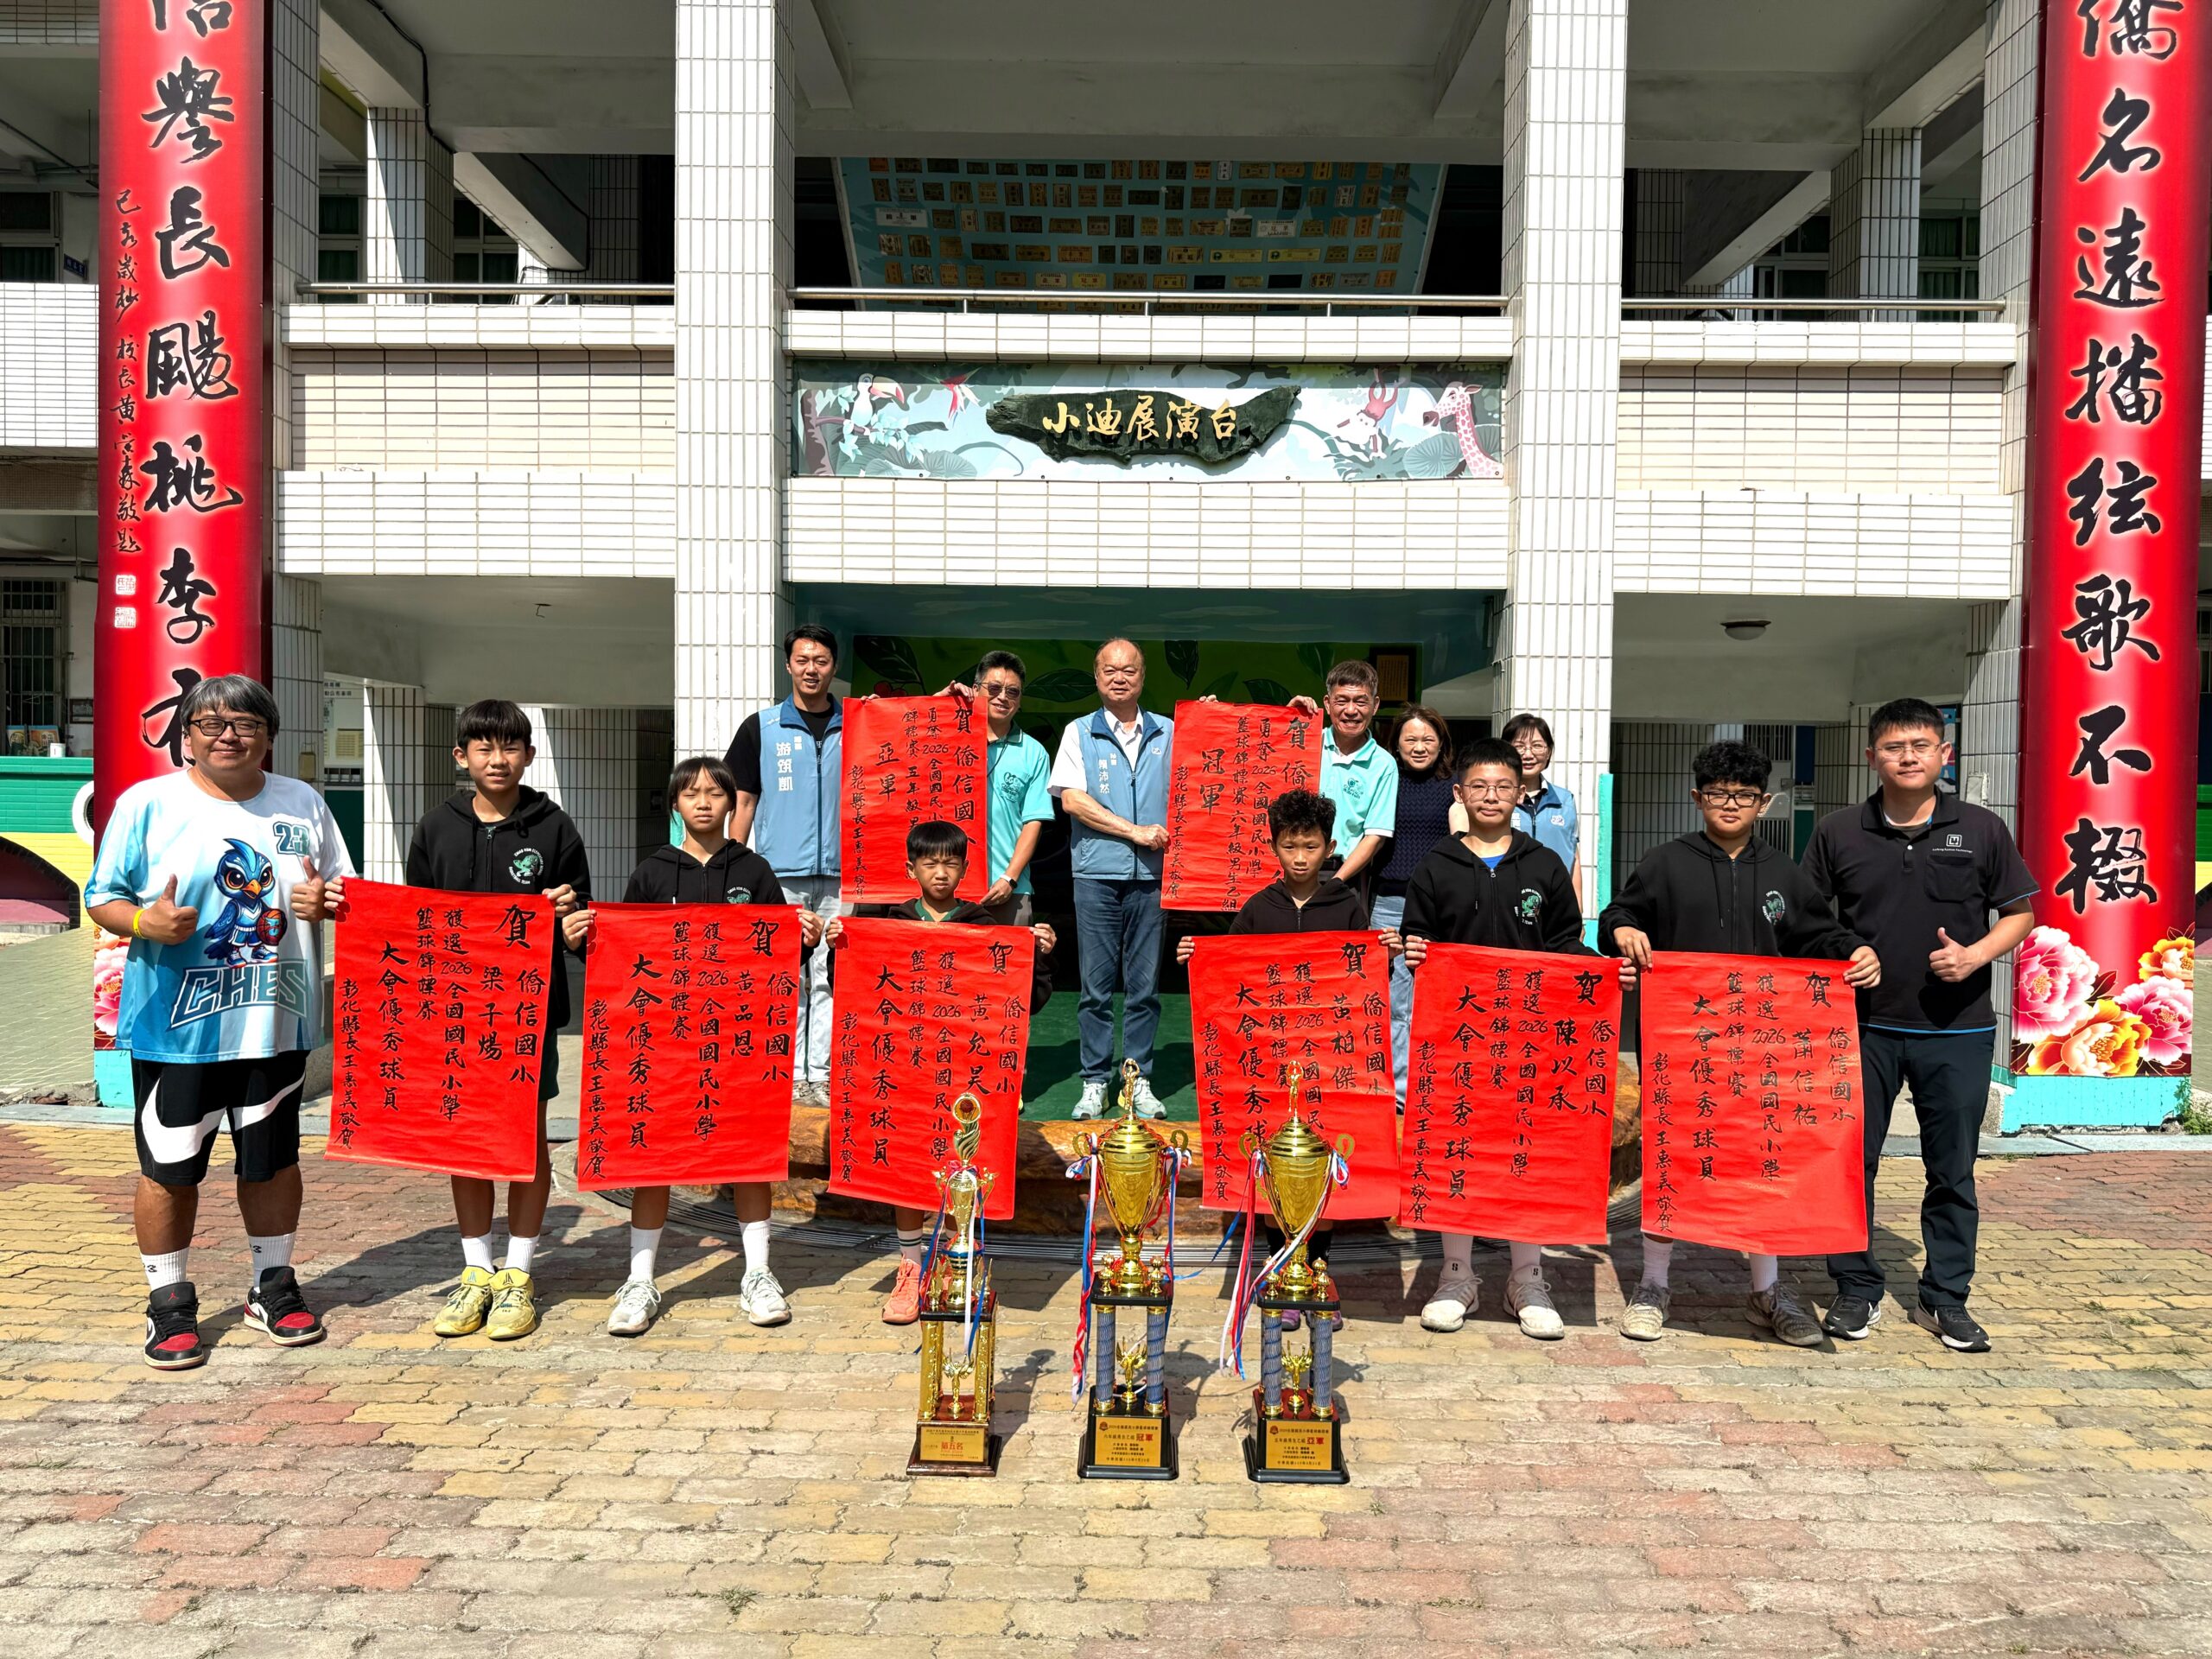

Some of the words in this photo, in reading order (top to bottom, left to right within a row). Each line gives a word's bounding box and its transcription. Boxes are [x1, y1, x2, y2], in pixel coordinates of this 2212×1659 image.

[1042, 395, 1236, 441] 小迪展演台
[953, 705, 974, 735] 賀
[1284, 716, 1313, 751] 賀
[876, 742, 900, 801] 亞軍
[953, 746, 980, 845] 僑信國
[1200, 748, 1225, 816] 冠軍
[272, 821, 310, 857] 23
[493, 904, 537, 950] 賀
[746, 918, 779, 957] 賀
[988, 941, 1014, 976] 賀
[1341, 943, 1368, 980] 賀
[166, 957, 311, 1032] CHES
[1574, 970, 1604, 1006] 賀
[1806, 971, 1832, 1008] 賀
[378, 941, 410, 1111] 大會優秀球員
[510, 969, 546, 1084] 僑信國小
[626, 954, 664, 1149] 大會優秀球員
[762, 971, 798, 1082] 僑信國小
[996, 996, 1027, 1093] 僑信國小
[1363, 992, 1387, 1094] 僑信國小
[870, 965, 904, 1166] 大會優秀球員
[1445, 986, 1488, 1200] 大會優秀球員
[1582, 1020, 1617, 1117] 僑信國小
[1689, 995, 1721, 1182] 大會優秀球員
[1827, 1027, 1856, 1122] 僑信國小
